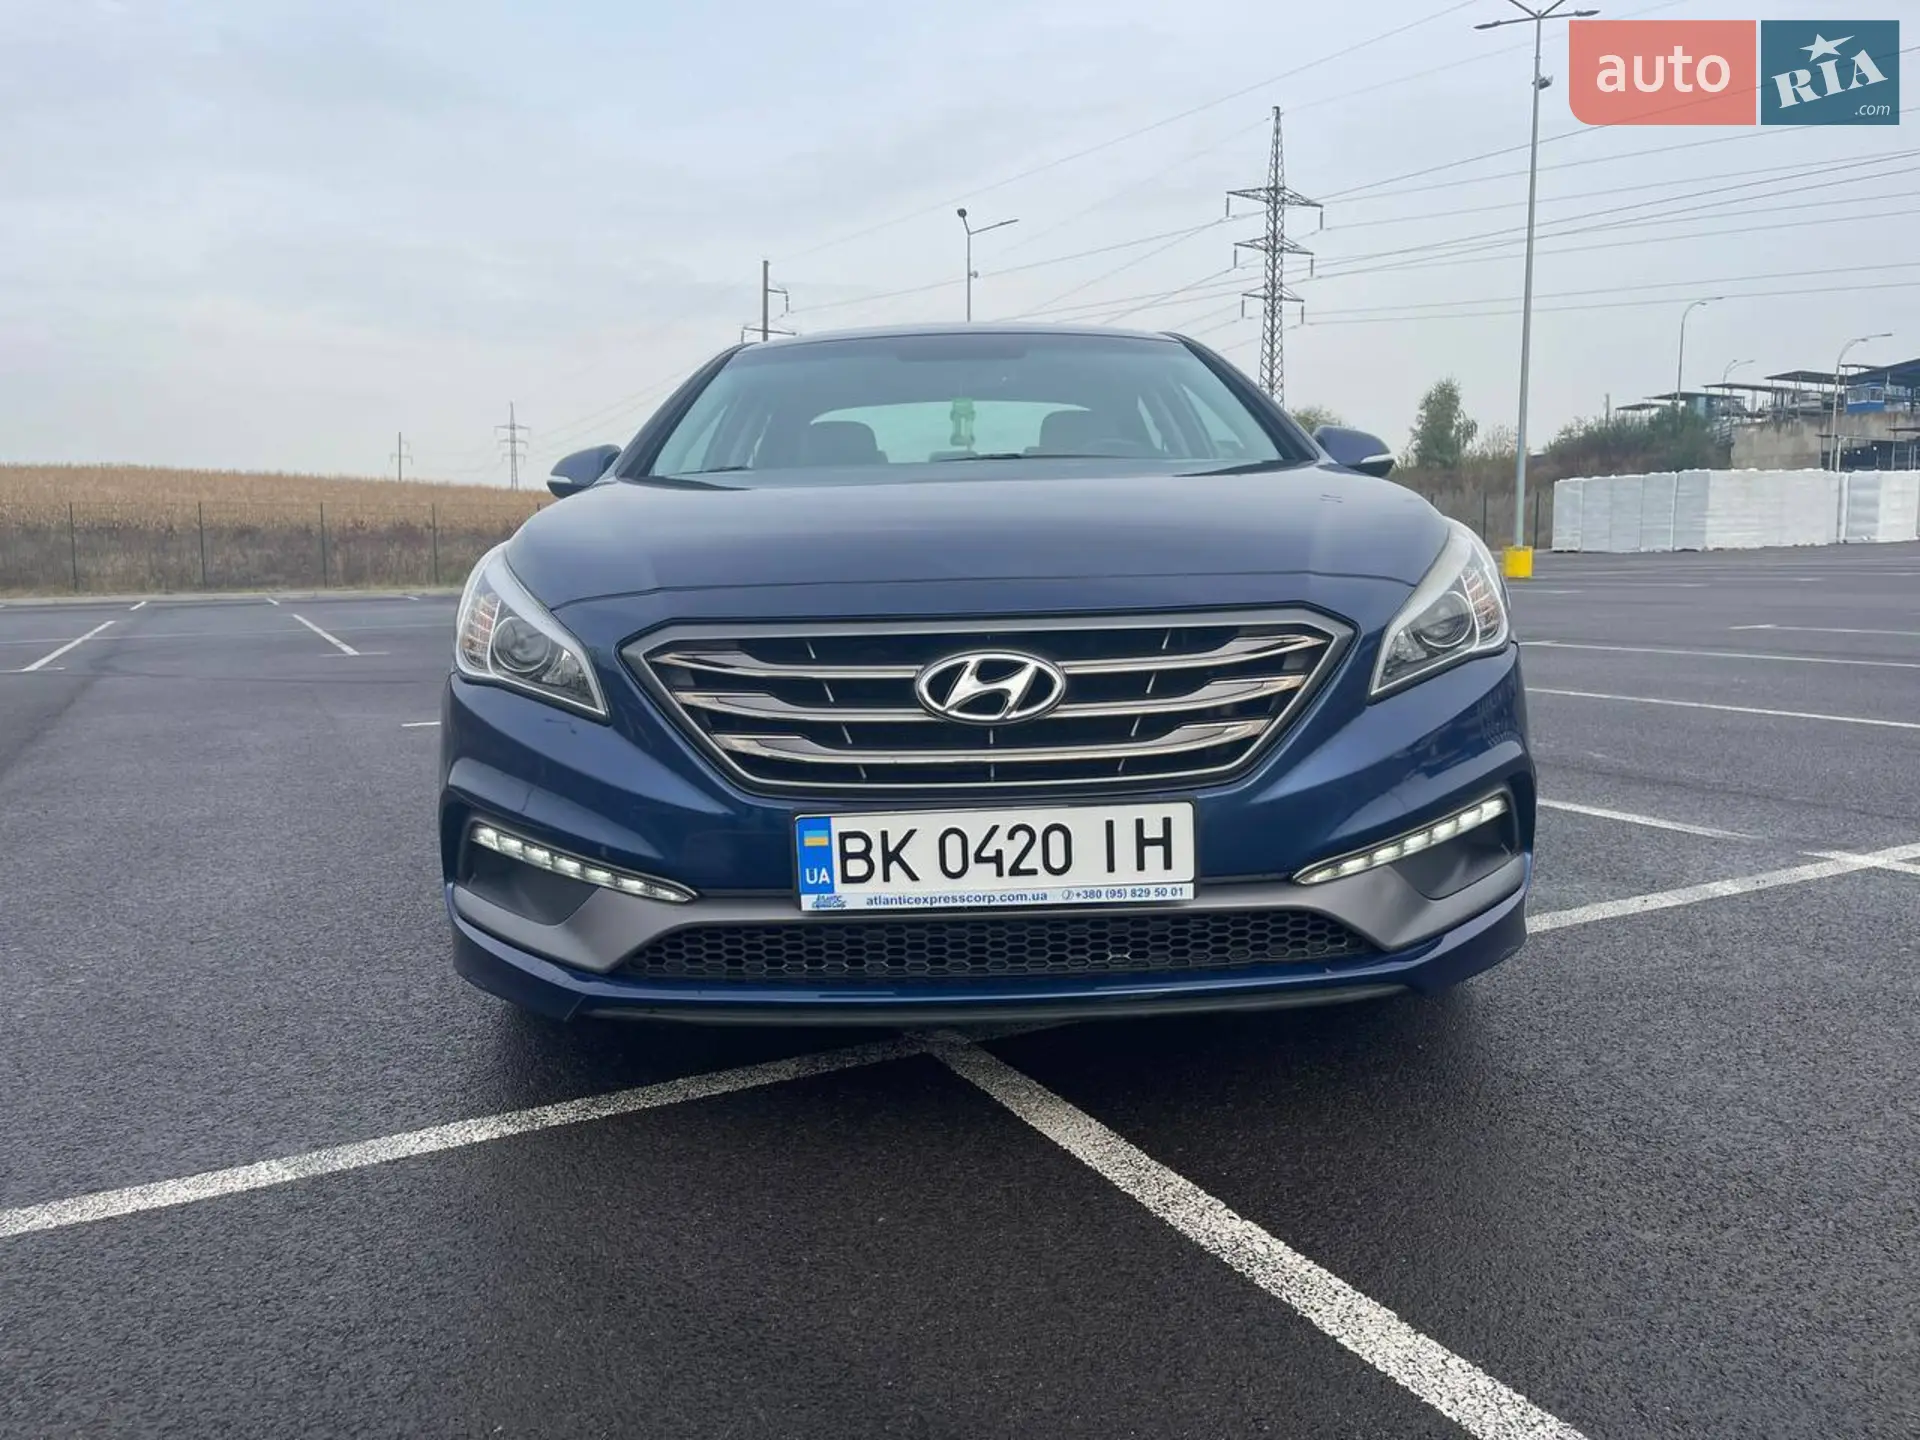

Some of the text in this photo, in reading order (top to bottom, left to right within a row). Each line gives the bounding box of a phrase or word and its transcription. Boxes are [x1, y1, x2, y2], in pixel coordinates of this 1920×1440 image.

[838, 816, 1173, 884] BK 0420 IH
[805, 867, 830, 885] UA
[866, 891, 1048, 907] atlanticexpresscorp.com.ua
[1075, 886, 1183, 900] +380 (95) 829 50 01
